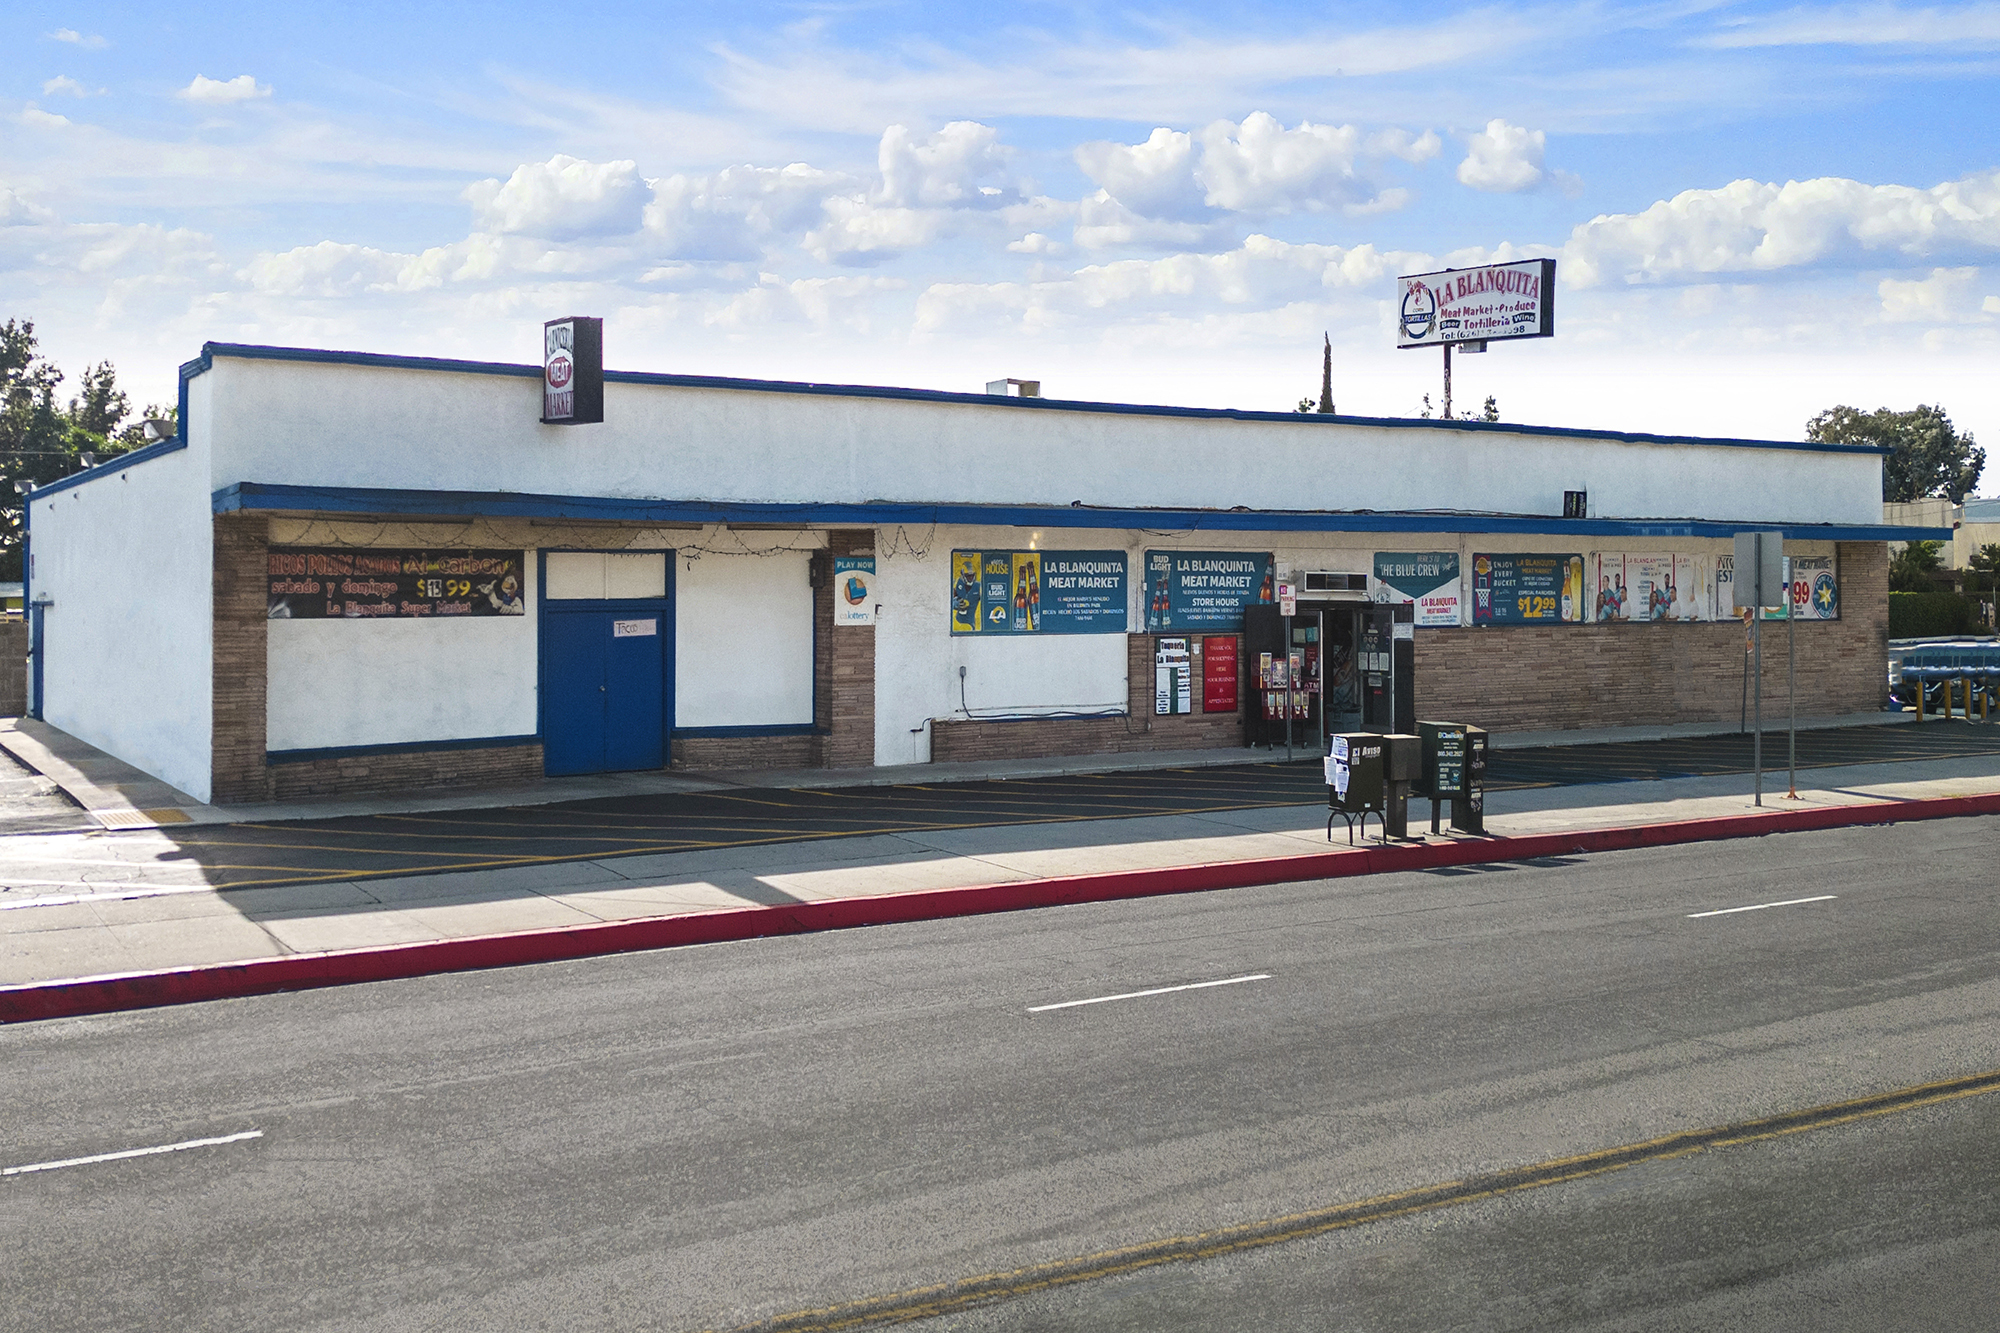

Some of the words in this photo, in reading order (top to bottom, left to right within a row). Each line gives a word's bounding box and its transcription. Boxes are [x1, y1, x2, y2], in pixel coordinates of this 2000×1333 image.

[1435, 281, 1455, 308] LA
[1457, 269, 1541, 300] BLANQUITA
[1440, 307, 1462, 319] Meat
[1462, 305, 1493, 317] Market
[1404, 314, 1432, 323] TORTILLAS
[1463, 315, 1510, 330] Tortilleria
[1513, 314, 1535, 322] Wine
[1441, 320, 1459, 328] Beer
[546, 391, 574, 416] MARKET
[1152, 555, 1169, 563] BUD
[268, 554, 306, 575] RICOS
[307, 554, 353, 576] POLLOS
[836, 561, 856, 569] PLAY
[857, 561, 874, 569] NOW
[985, 564, 1009, 575] HOUSE
[1044, 561, 1058, 573] LA
[1059, 561, 1124, 575] BLANQUINTA
[1150, 563, 1172, 571] LIGHT
[1177, 560, 1190, 572] LA
[1191, 560, 1256, 574] BLANQUINTA
[1380, 564, 1394, 577] THE
[1395, 564, 1416, 577] BLUE
[1417, 564, 1440, 577] CREW
[1048, 577, 1077, 588] MEAT
[1078, 577, 1119, 588] MARKET
[1181, 575, 1209, 587] MEAT
[1210, 576, 1252, 588] MARKET
[1493, 579, 1516, 587] BUCKET
[271, 578, 320, 594] sabado
[326, 582, 336, 598] y
[341, 578, 398, 598] domingo
[1192, 598, 1214, 606] STORE
[1215, 598, 1240, 606] HOURS
[1421, 598, 1428, 606] LA
[1429, 597, 1458, 606] BLANQUITA
[326, 601, 341, 615] La
[345, 601, 397, 617] Blanquita
[401, 600, 431, 617] Super
[436, 600, 472, 614] Market
[1157, 655, 1164, 664] La
